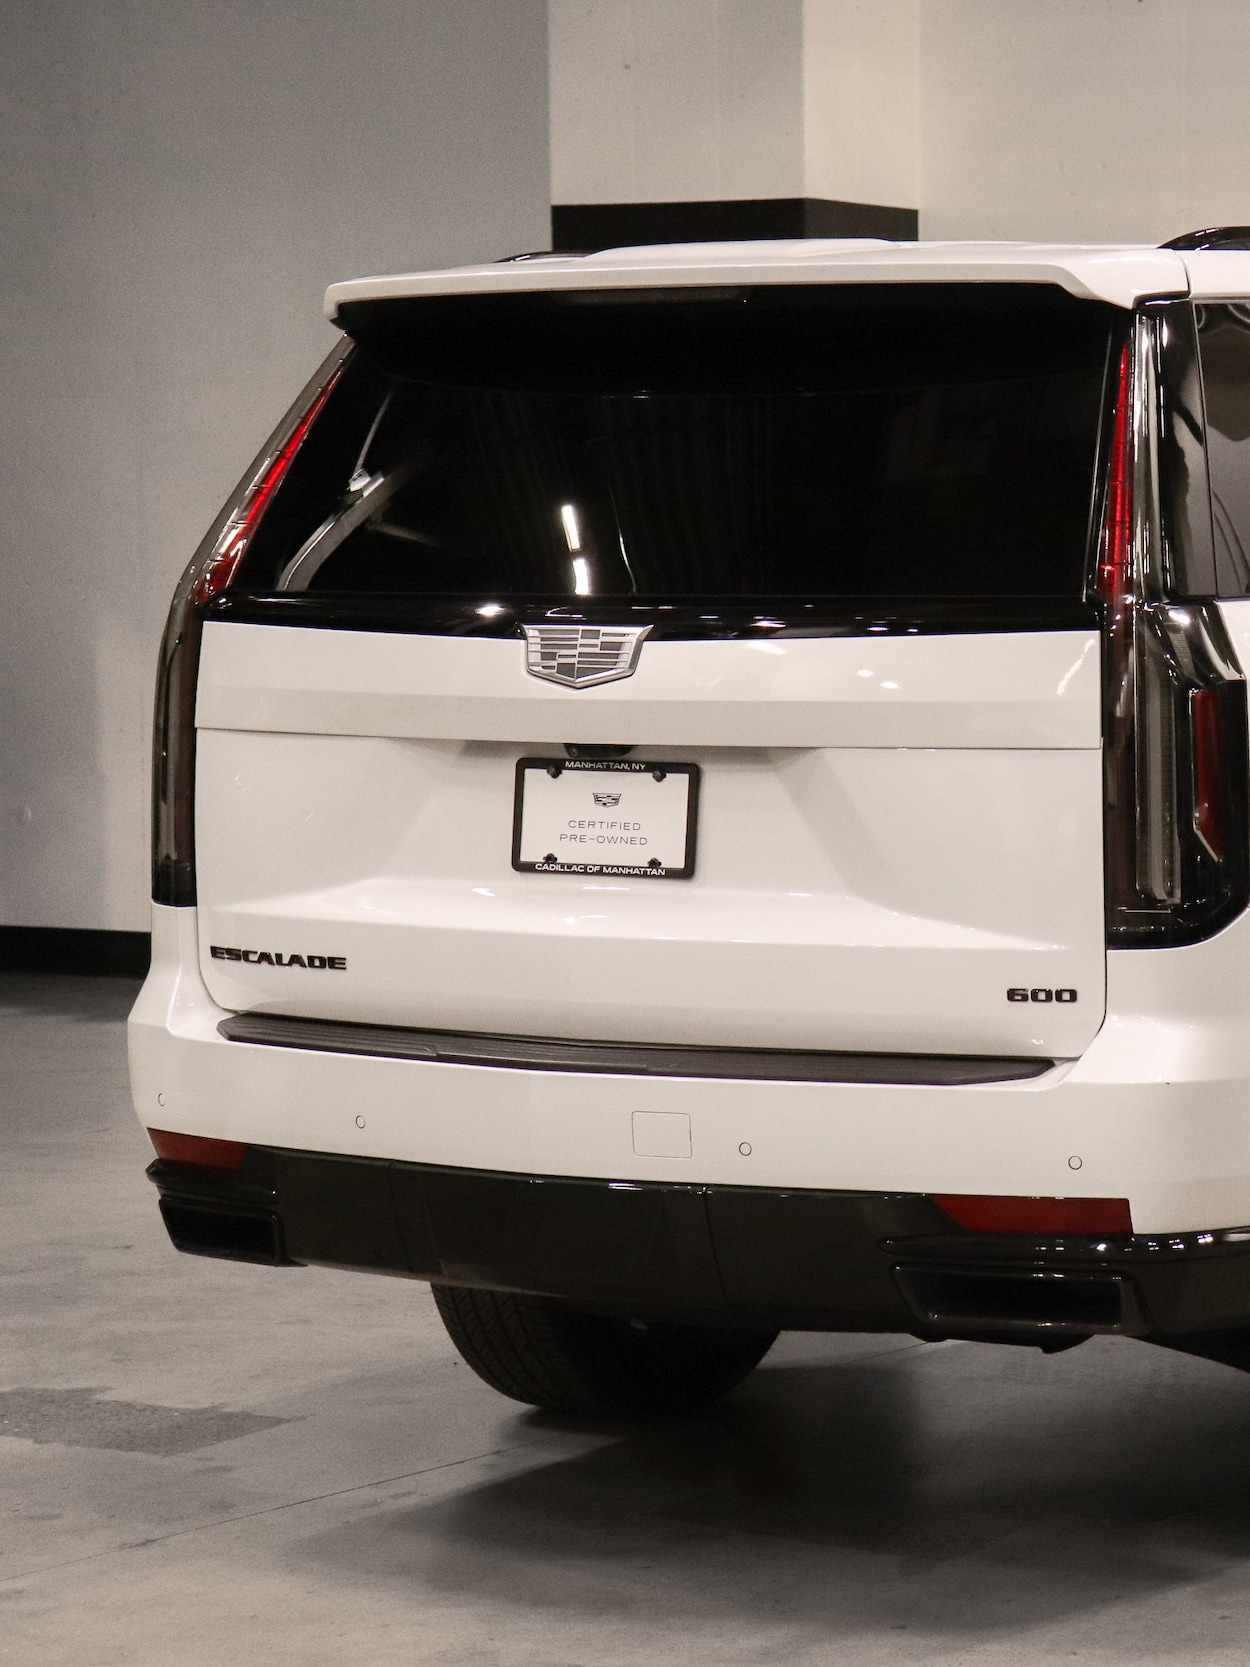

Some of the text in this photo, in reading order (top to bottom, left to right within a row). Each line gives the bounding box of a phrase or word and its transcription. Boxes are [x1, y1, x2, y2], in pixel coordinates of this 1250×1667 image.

[565, 760, 630, 771] MANHATTAN,
[568, 819, 641, 831] CERTIFIED
[559, 834, 648, 846] PRE-OWNED
[535, 863, 585, 873] CADILLAC
[602, 866, 666, 876] MANHATTAN
[210, 945, 347, 970] ESCALADE
[1006, 987, 1078, 1002] 600
